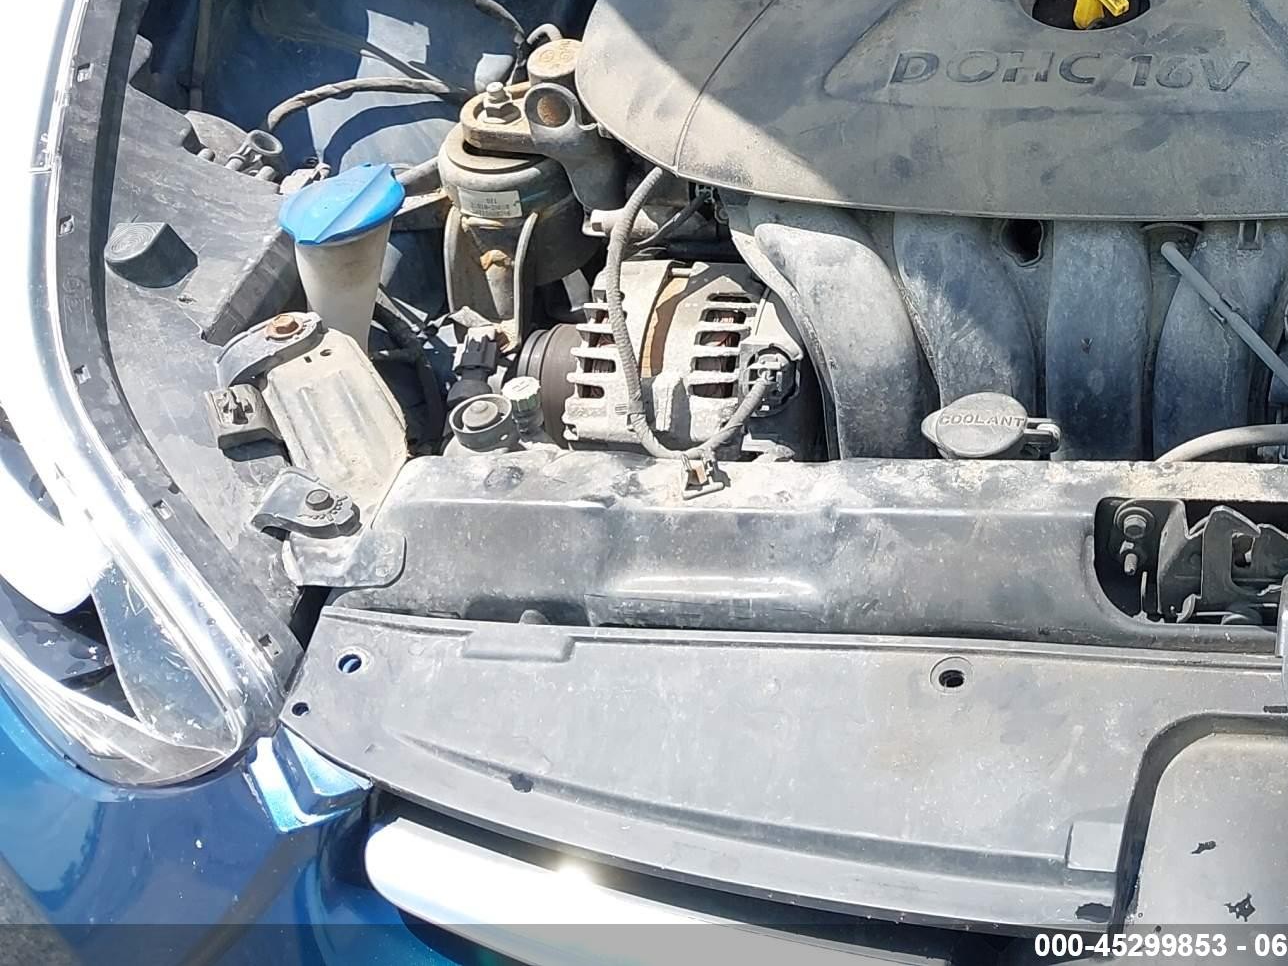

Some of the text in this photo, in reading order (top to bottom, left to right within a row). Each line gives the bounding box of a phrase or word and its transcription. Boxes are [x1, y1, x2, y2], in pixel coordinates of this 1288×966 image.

[889, 50, 1250, 92] DOHC 16V
[940, 414, 1025, 427] COOLANT
